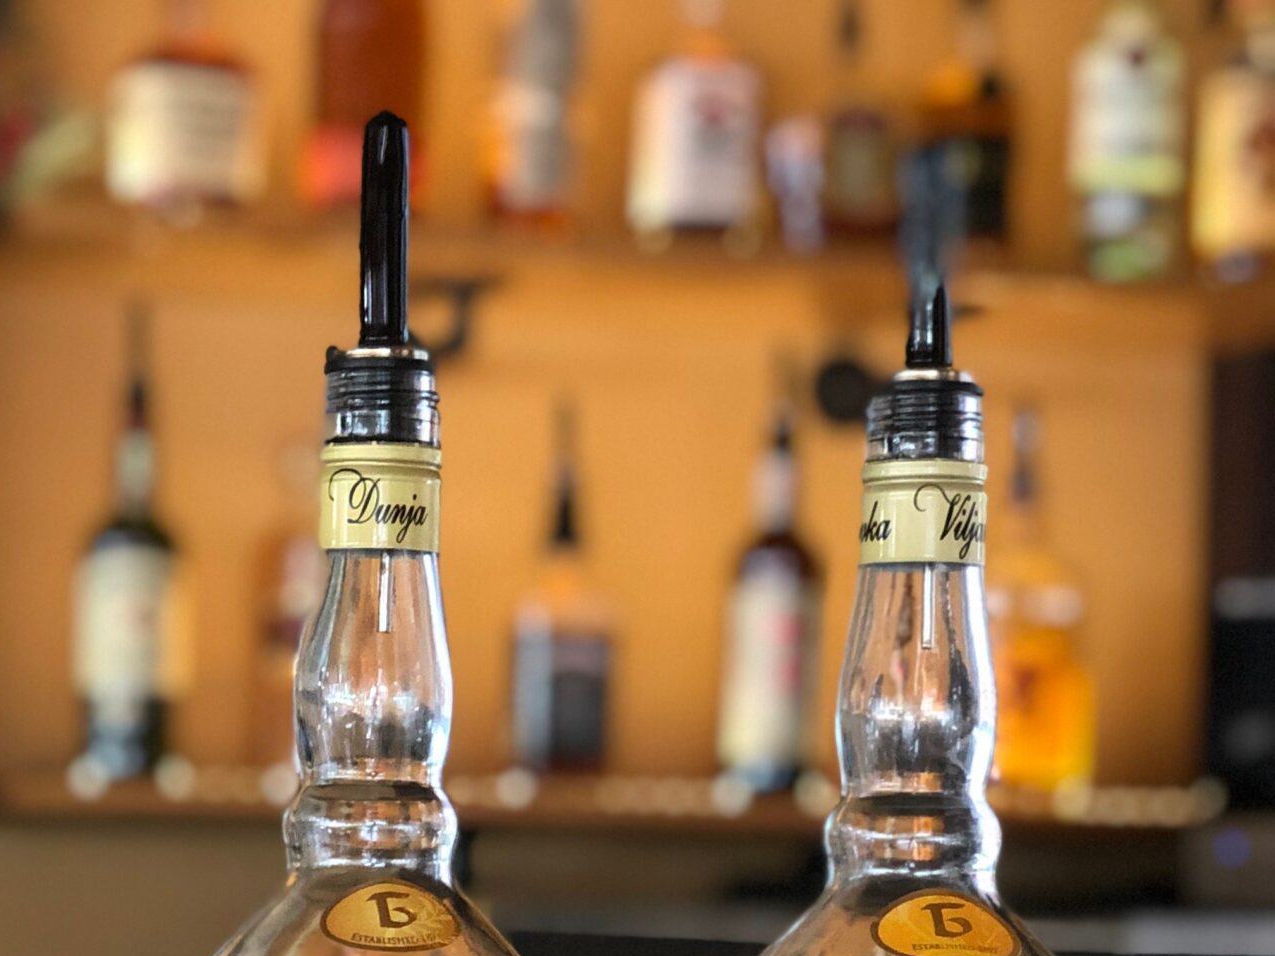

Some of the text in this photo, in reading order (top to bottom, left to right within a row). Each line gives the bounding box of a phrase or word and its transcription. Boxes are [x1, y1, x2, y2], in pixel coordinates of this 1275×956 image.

[328, 468, 428, 543] Dunja
[913, 483, 985, 559] Vilja
[351, 933, 419, 945] ESTABLISHED
